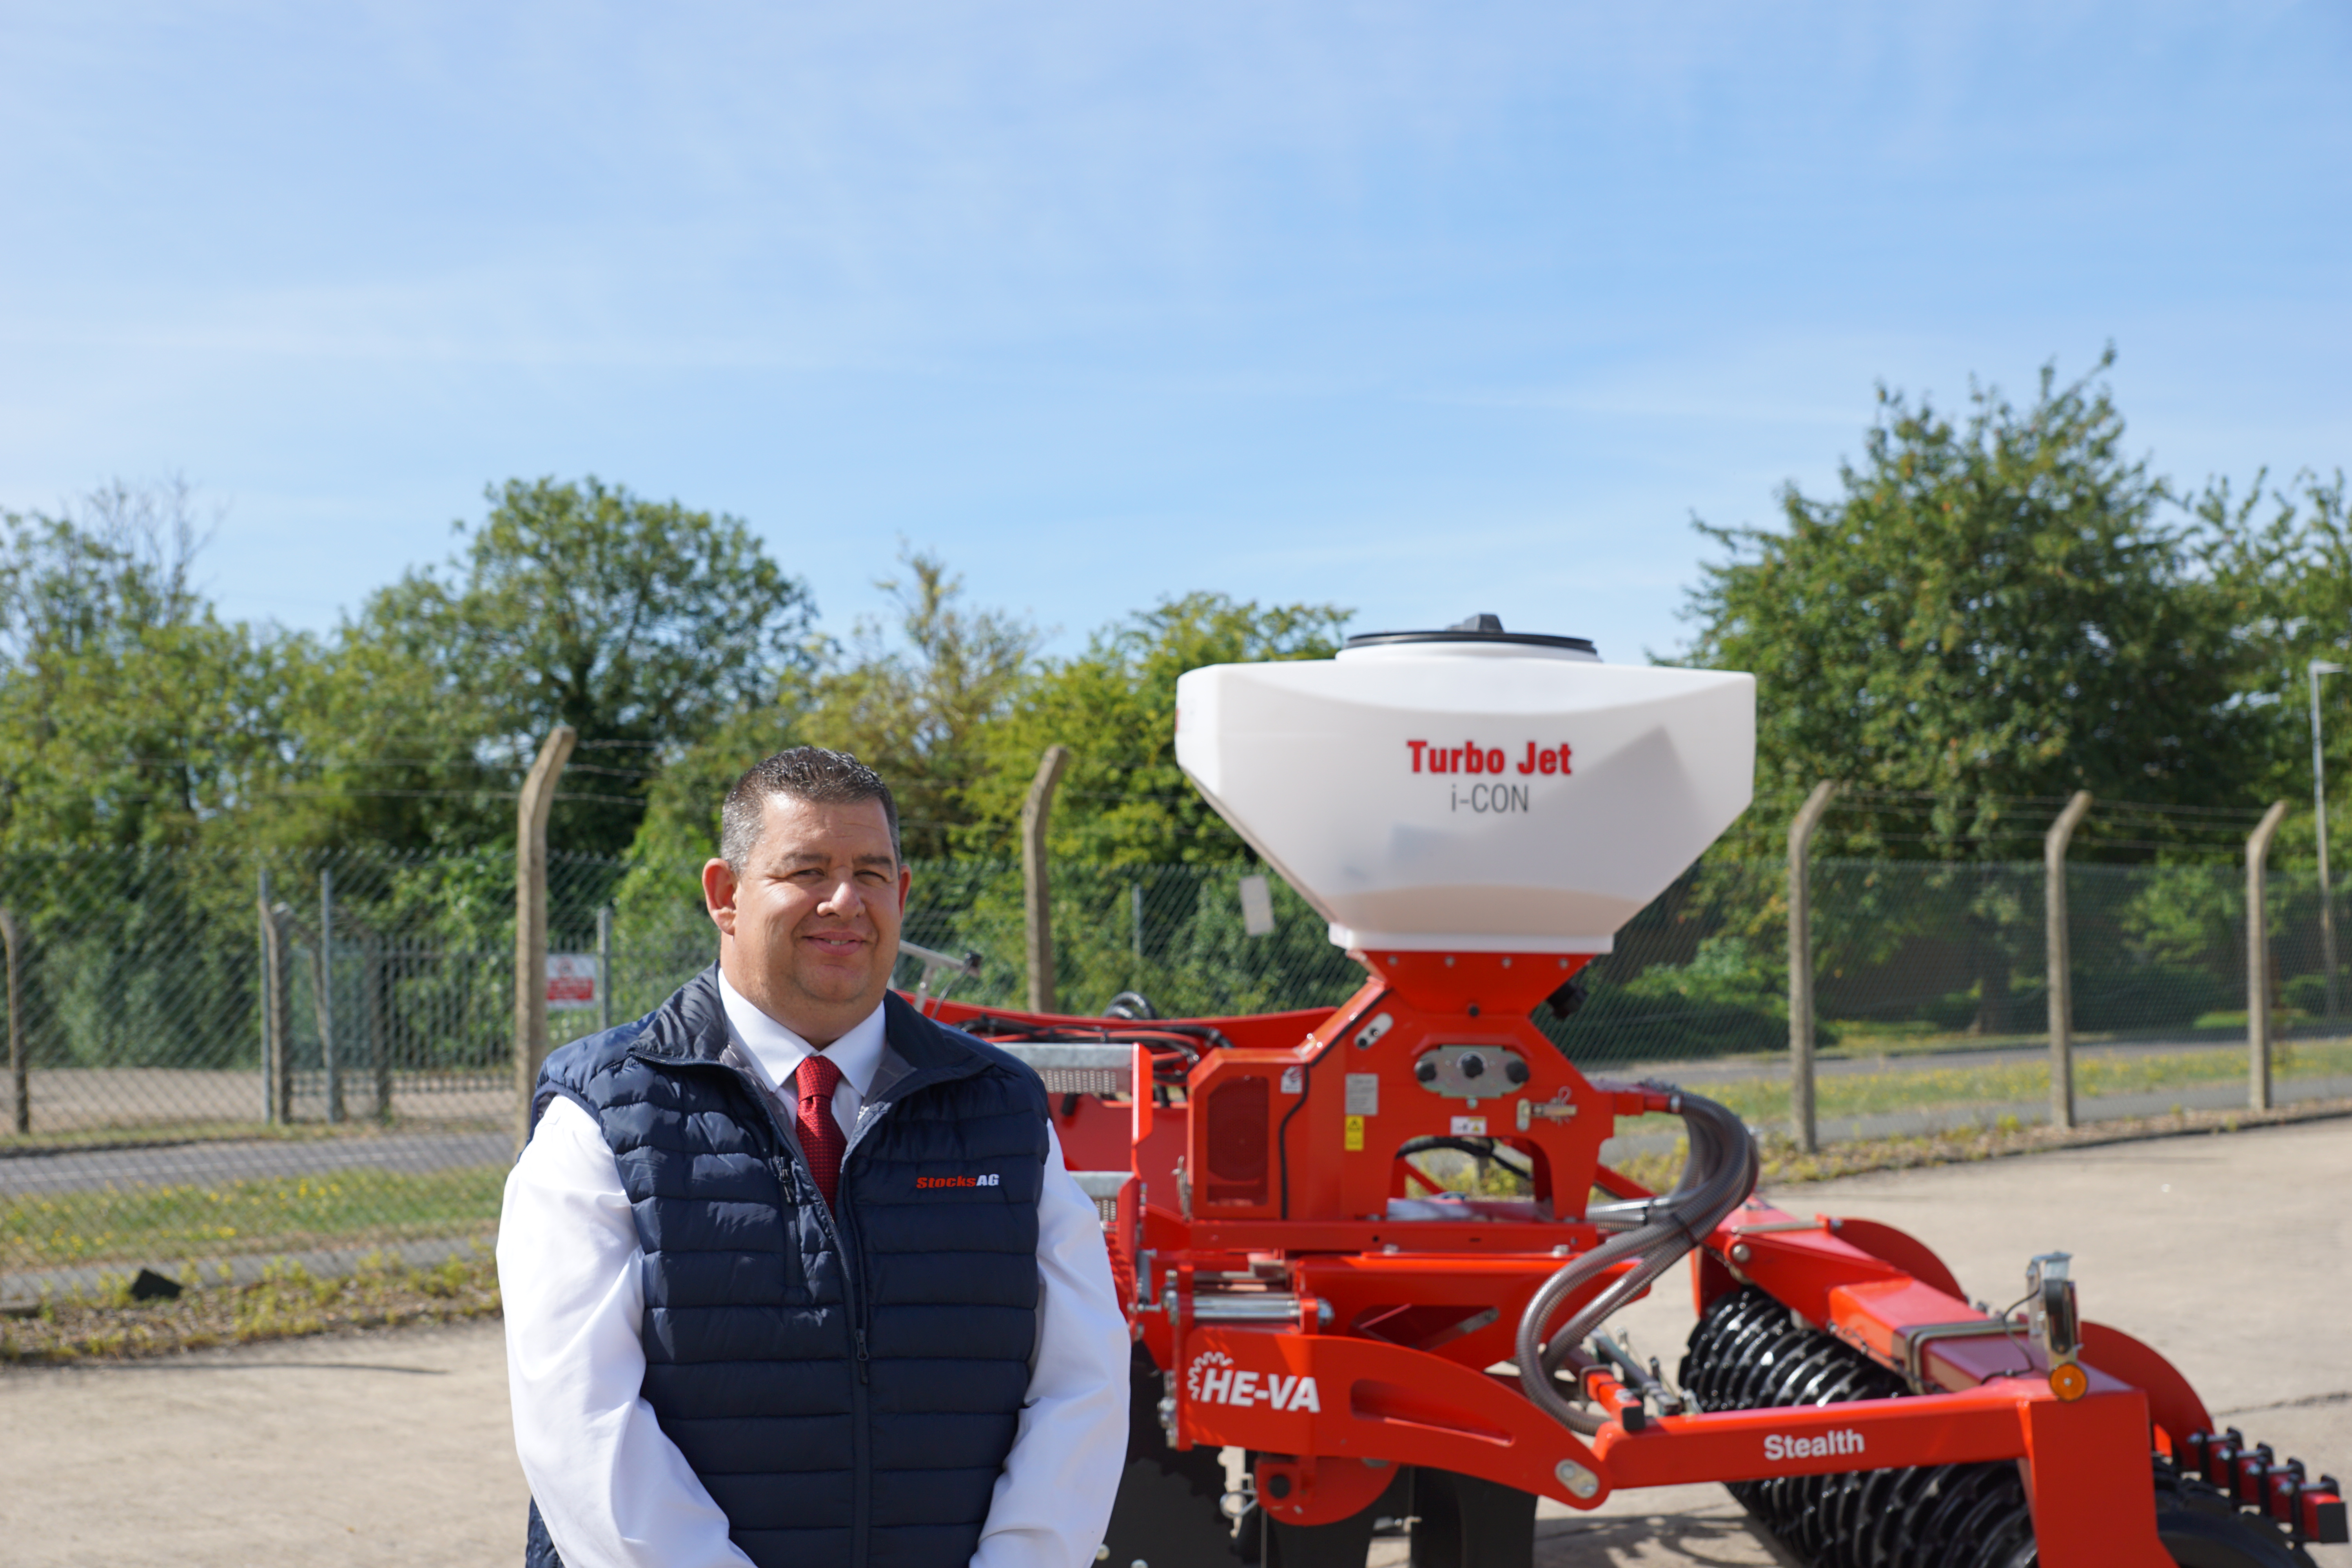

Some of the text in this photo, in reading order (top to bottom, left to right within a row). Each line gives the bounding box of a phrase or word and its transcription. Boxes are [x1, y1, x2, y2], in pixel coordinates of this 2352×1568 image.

[1407, 740, 1572, 775] Turbo Jet
[1451, 784, 1529, 813] i-CON
[916, 1174, 999, 1189] StocksAG
[1200, 1368, 1321, 1413] HE-VA
[1764, 1428, 1865, 1461] Stealth
